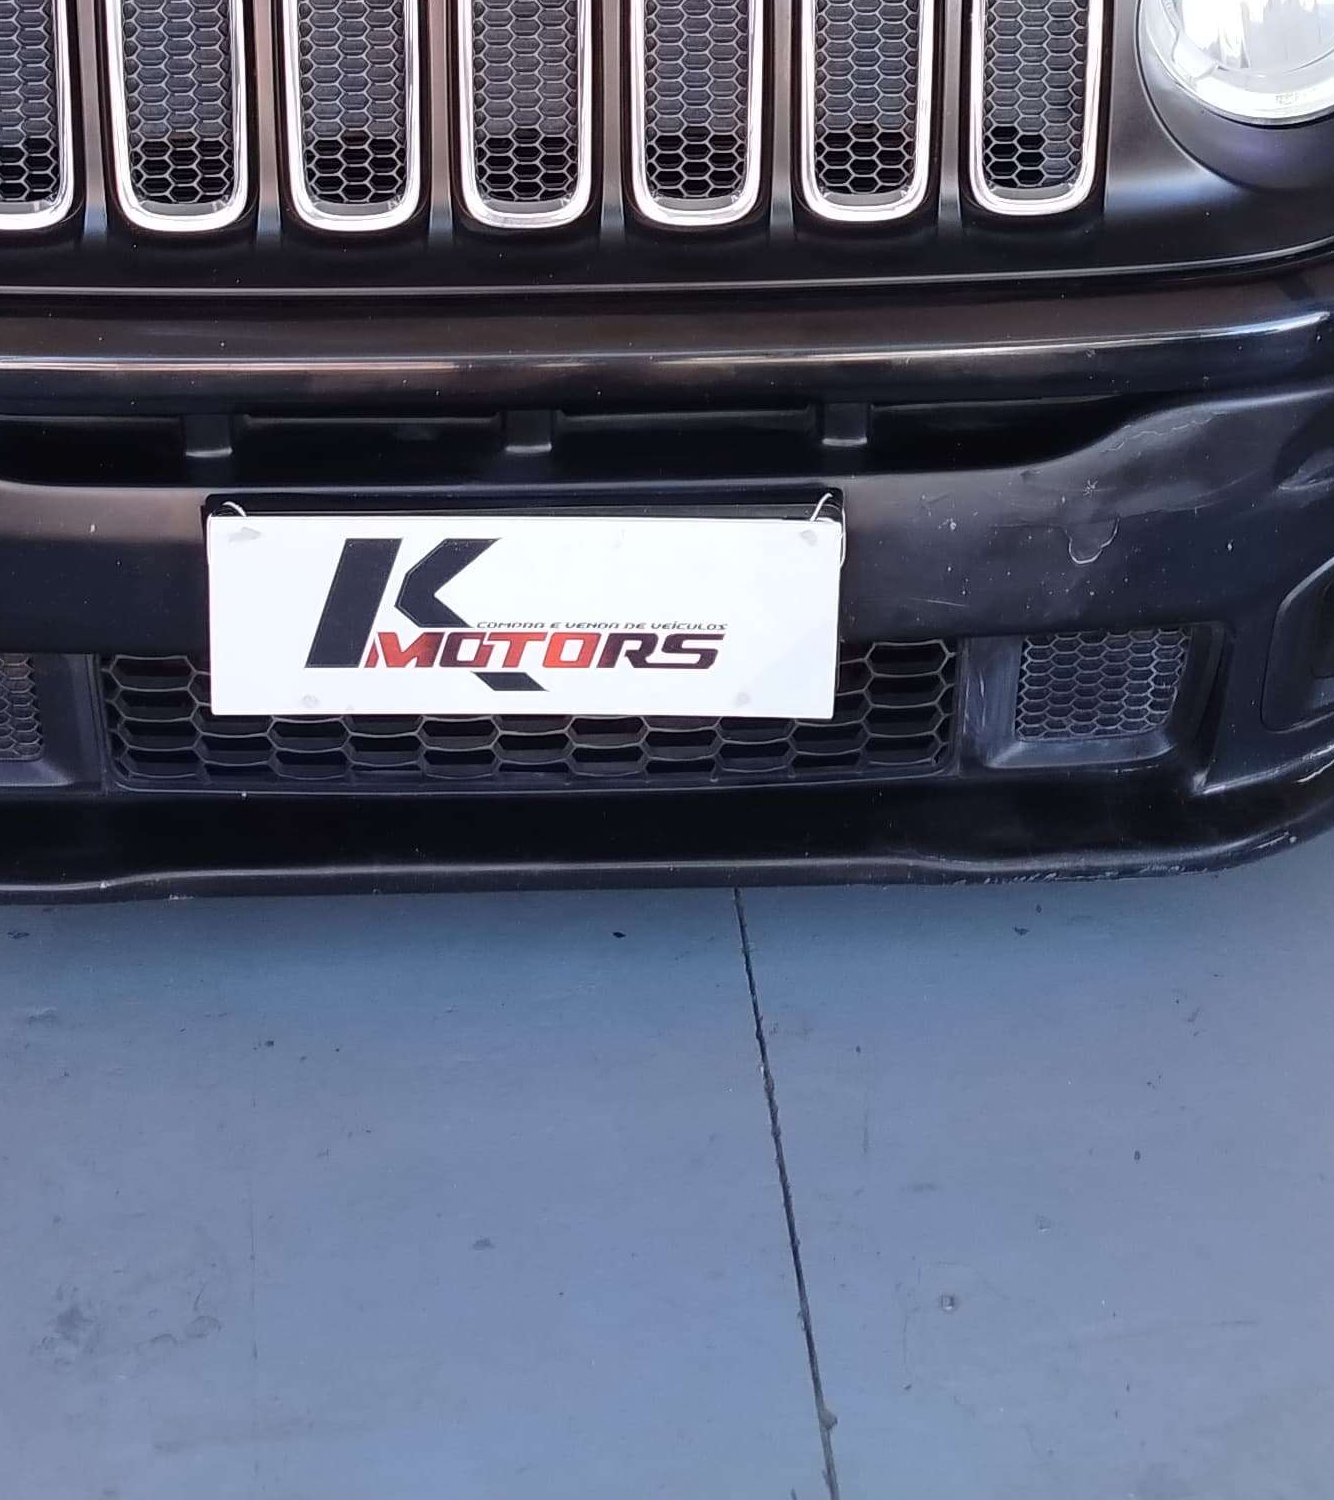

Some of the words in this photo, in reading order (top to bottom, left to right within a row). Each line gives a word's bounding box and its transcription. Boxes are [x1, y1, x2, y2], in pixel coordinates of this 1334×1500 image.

[304, 537, 549, 692] K
[476, 621, 545, 629] COMPRA
[564, 621, 619, 629] VENDA
[623, 621, 647, 630] DE
[650, 621, 728, 631] VEÍCULOS
[366, 631, 726, 669] MOTORS
